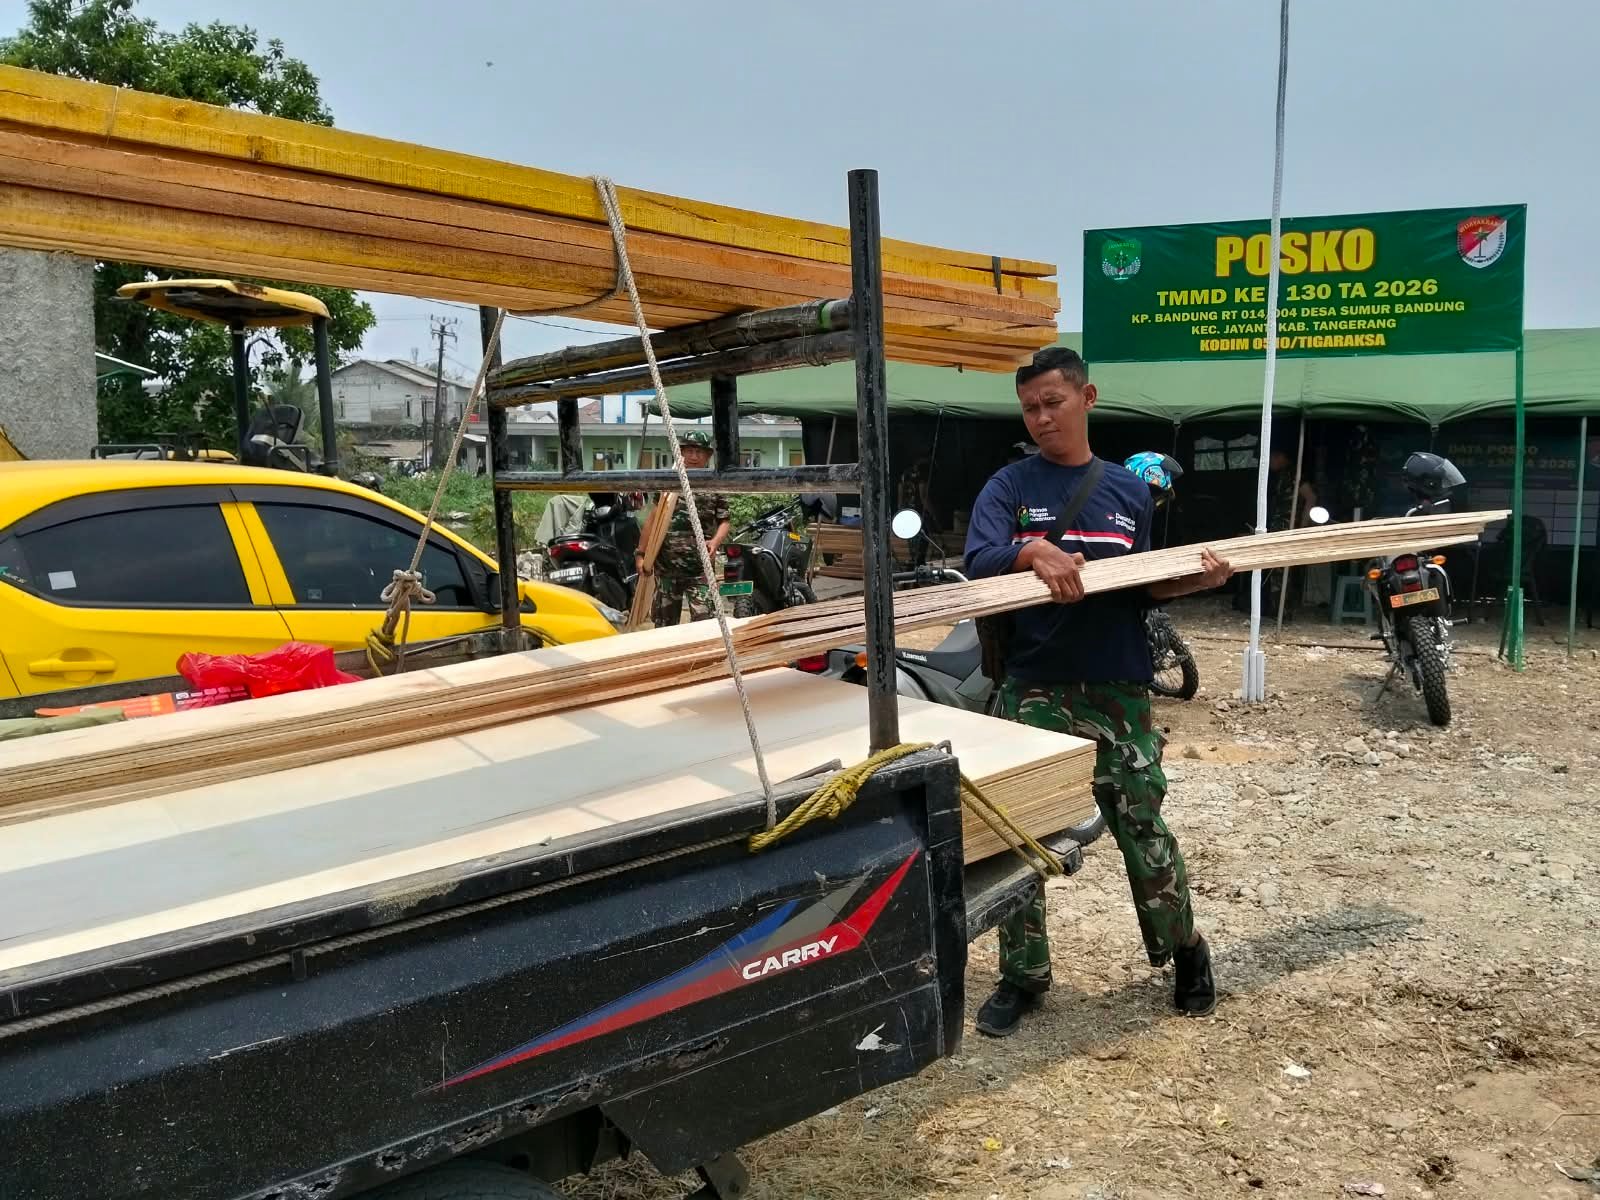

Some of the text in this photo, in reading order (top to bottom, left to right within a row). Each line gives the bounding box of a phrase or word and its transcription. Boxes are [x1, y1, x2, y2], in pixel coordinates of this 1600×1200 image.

[1215, 228, 1375, 277] POSKO
[1157, 279, 1439, 306] TMMD KE 130 TA 2026
[1131, 313, 1152, 324] KP.
[1154, 310, 1218, 323] BANDUNG
[1221, 310, 1238, 321] RT
[1301, 306, 1337, 318] DESA
[1340, 304, 1391, 316] SUMUR
[1394, 301, 1465, 314] BANDUNG
[1191, 318, 1397, 335] KEC. JAYANT KAB. TANGERANG
[1200, 338, 1250, 352] KODIM
[742, 935, 838, 980] CARRY
